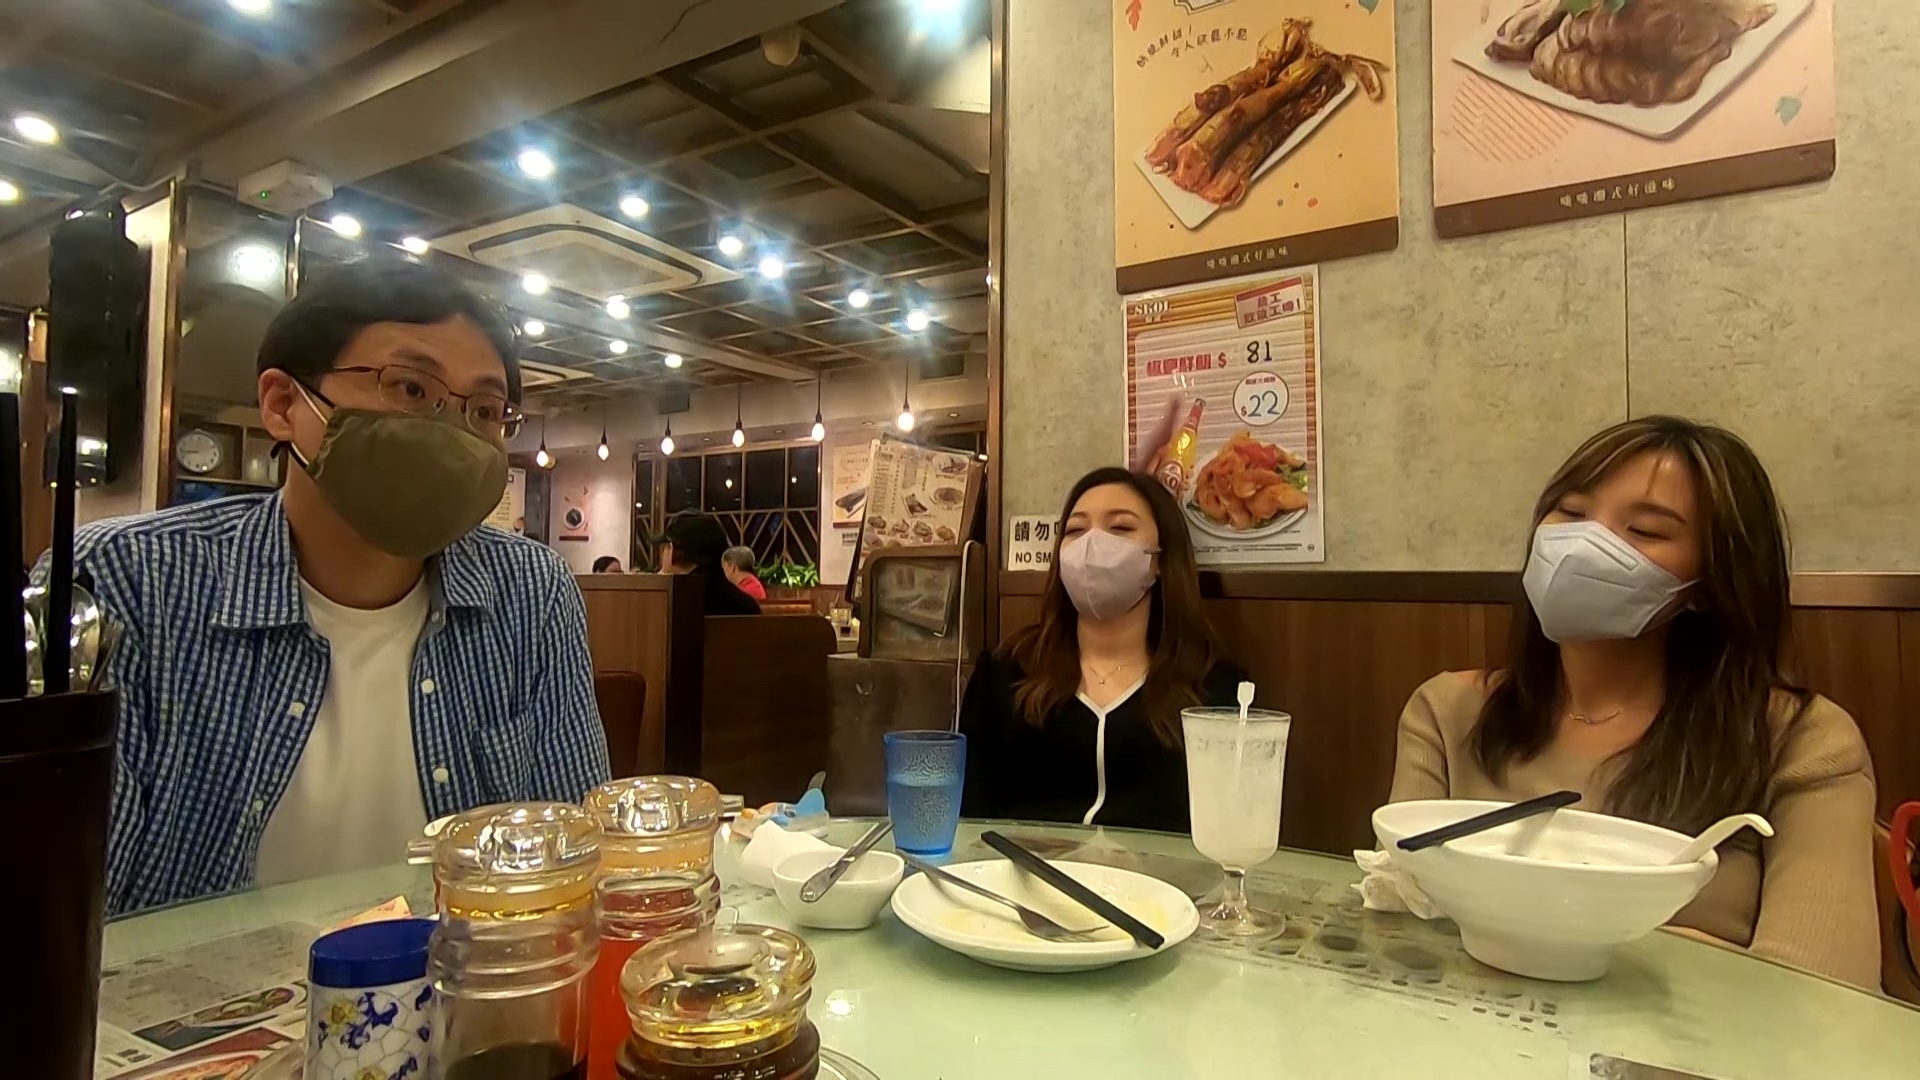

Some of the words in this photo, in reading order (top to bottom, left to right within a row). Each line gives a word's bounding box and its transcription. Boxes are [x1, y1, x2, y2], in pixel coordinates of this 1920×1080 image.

[1217, 352, 1227, 369] $
[1246, 340, 1273, 364] 81
[1015, 551, 1032, 564] NO
[1035, 551, 1052, 564] SM
